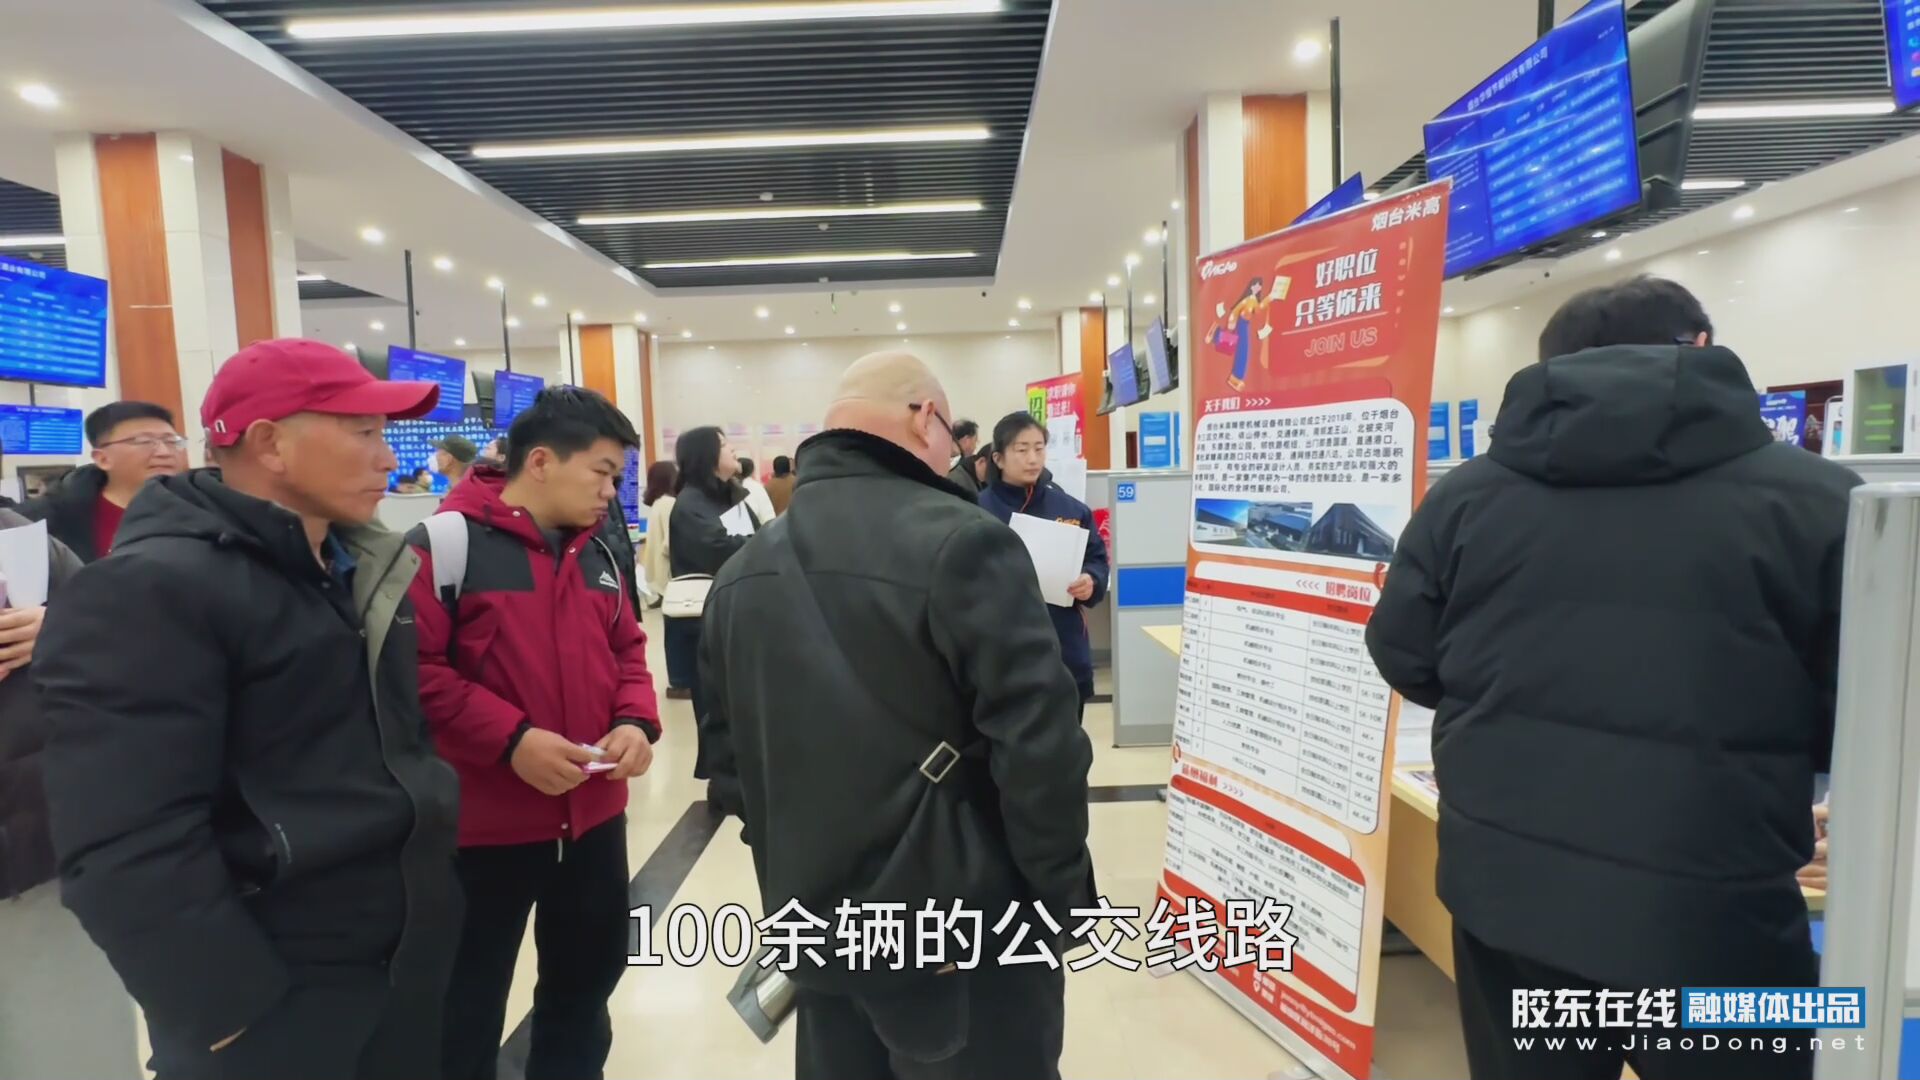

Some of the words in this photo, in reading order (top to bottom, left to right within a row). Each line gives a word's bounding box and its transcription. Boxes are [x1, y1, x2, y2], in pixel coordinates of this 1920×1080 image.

[1371, 196, 1441, 232] 烟台米高
[1316, 248, 1378, 288] 好职位
[1295, 282, 1381, 327] 只等你来
[1304, 333, 1346, 357] JOIN
[1350, 328, 1377, 348] US
[1205, 397, 1240, 412] 关于我们
[1118, 487, 1134, 498] 59
[1326, 581, 1371, 602] 招聘岗位
